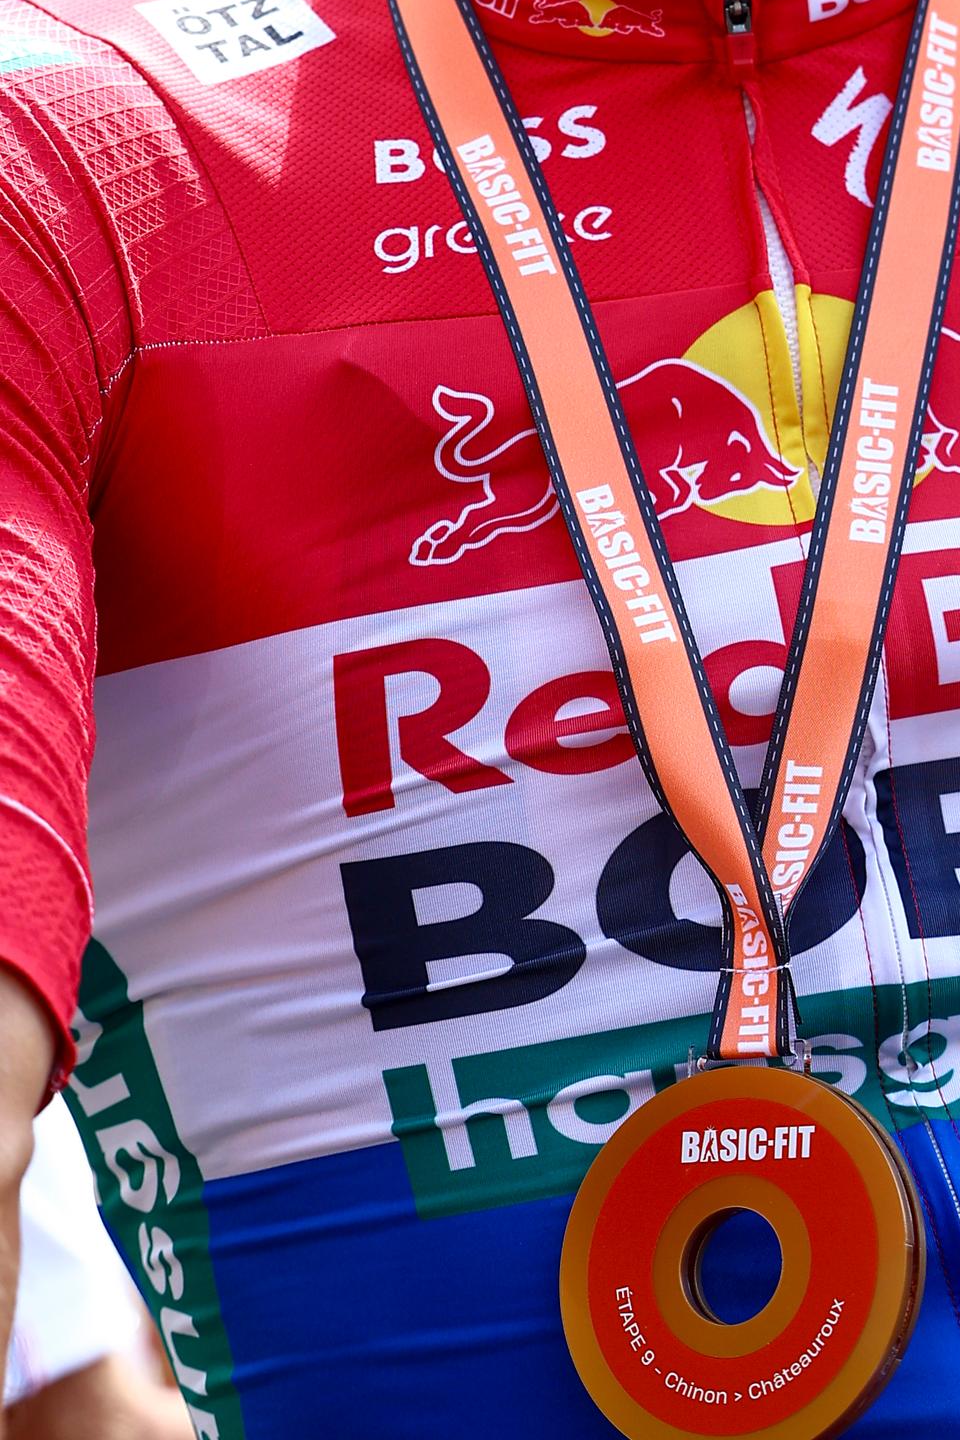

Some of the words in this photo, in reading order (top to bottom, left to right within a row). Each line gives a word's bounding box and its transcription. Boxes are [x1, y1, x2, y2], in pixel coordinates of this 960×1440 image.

[195, 24, 304, 64] TAL
[916, 12, 960, 173] BASIC-FIT
[373, 104, 607, 185] BSS
[456, 133, 558, 277] BASIC-FIT
[373, 205, 613, 274] gree
[849, 378, 901, 545] BASIC-FIT
[576, 484, 679, 645] BASIC-FIT
[772, 759, 824, 910] ASIC-FIT
[681, 1125, 815, 1164] BASIC-FIT
[615, 1286, 647, 1352] ÉTAPE
[640, 1349, 656, 1367] 9
[664, 1370, 728, 1405] Chinon
[747, 1297, 845, 1400] Châteauroux
